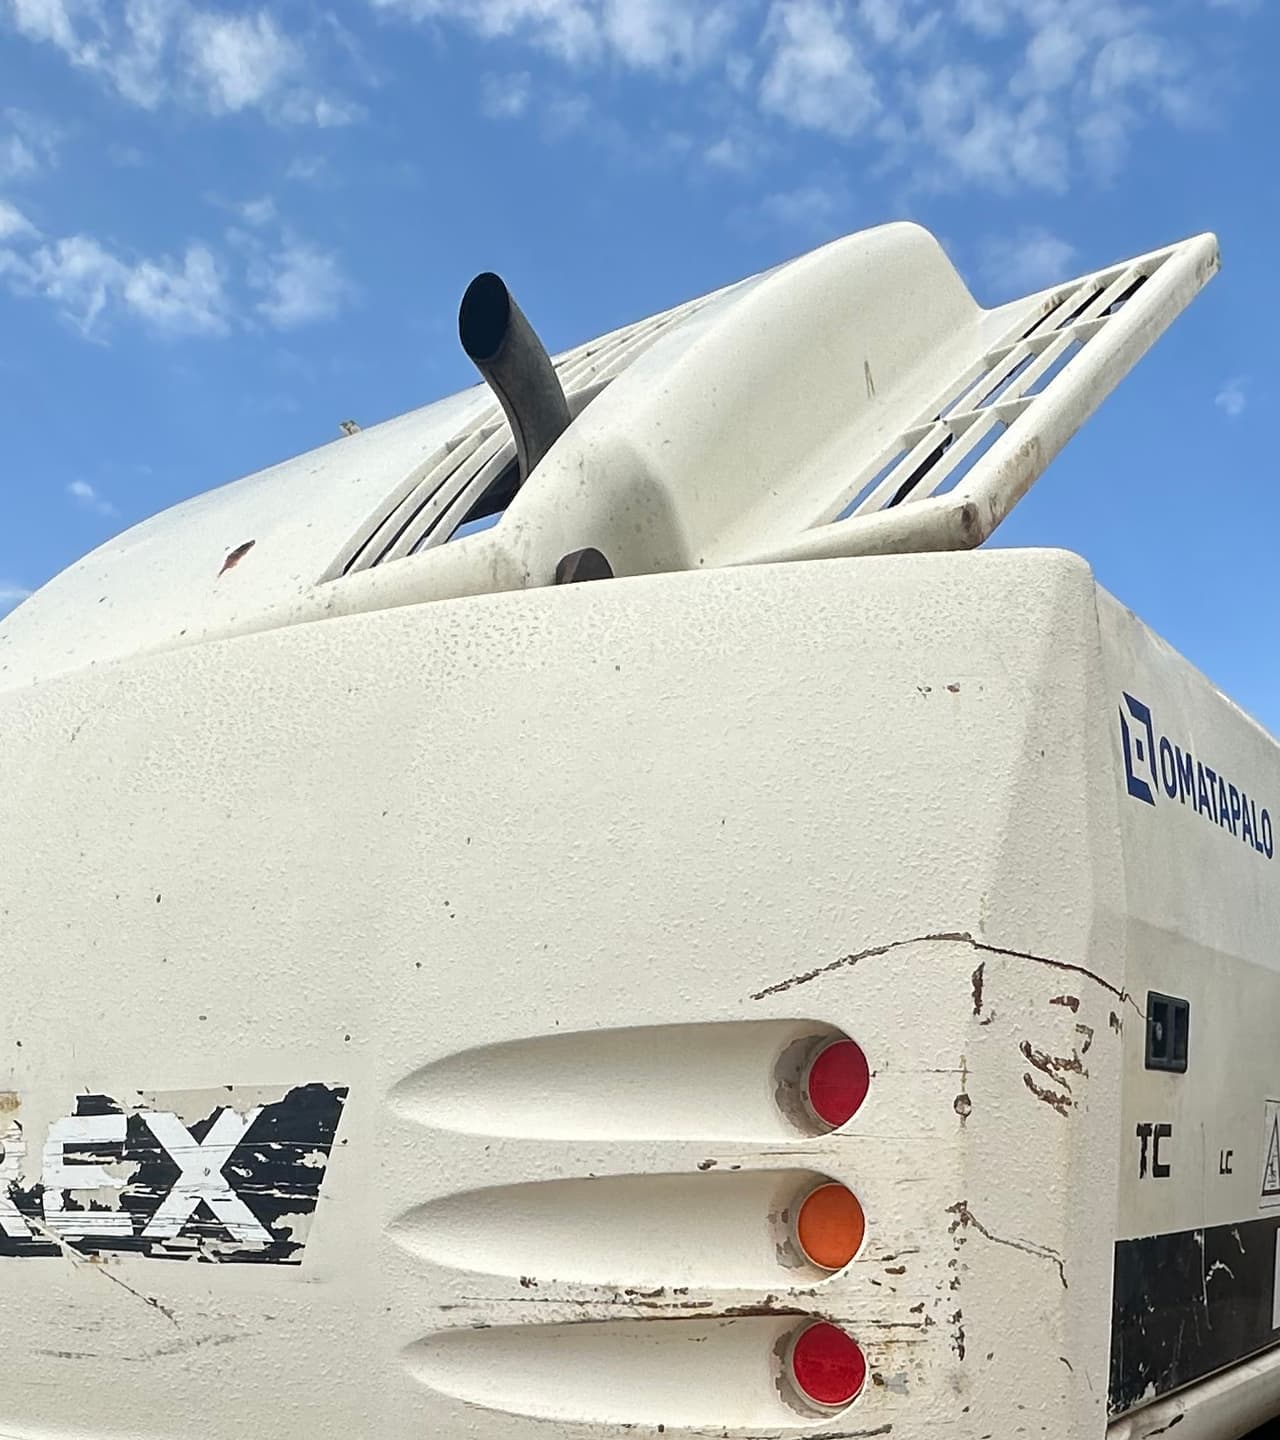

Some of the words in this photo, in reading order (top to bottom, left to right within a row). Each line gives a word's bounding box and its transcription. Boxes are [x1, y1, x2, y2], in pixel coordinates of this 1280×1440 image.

[1159, 736, 1274, 860] OMATAPALO
[1136, 1122, 1171, 1179] TC
[1219, 1150, 1233, 1175] LC
